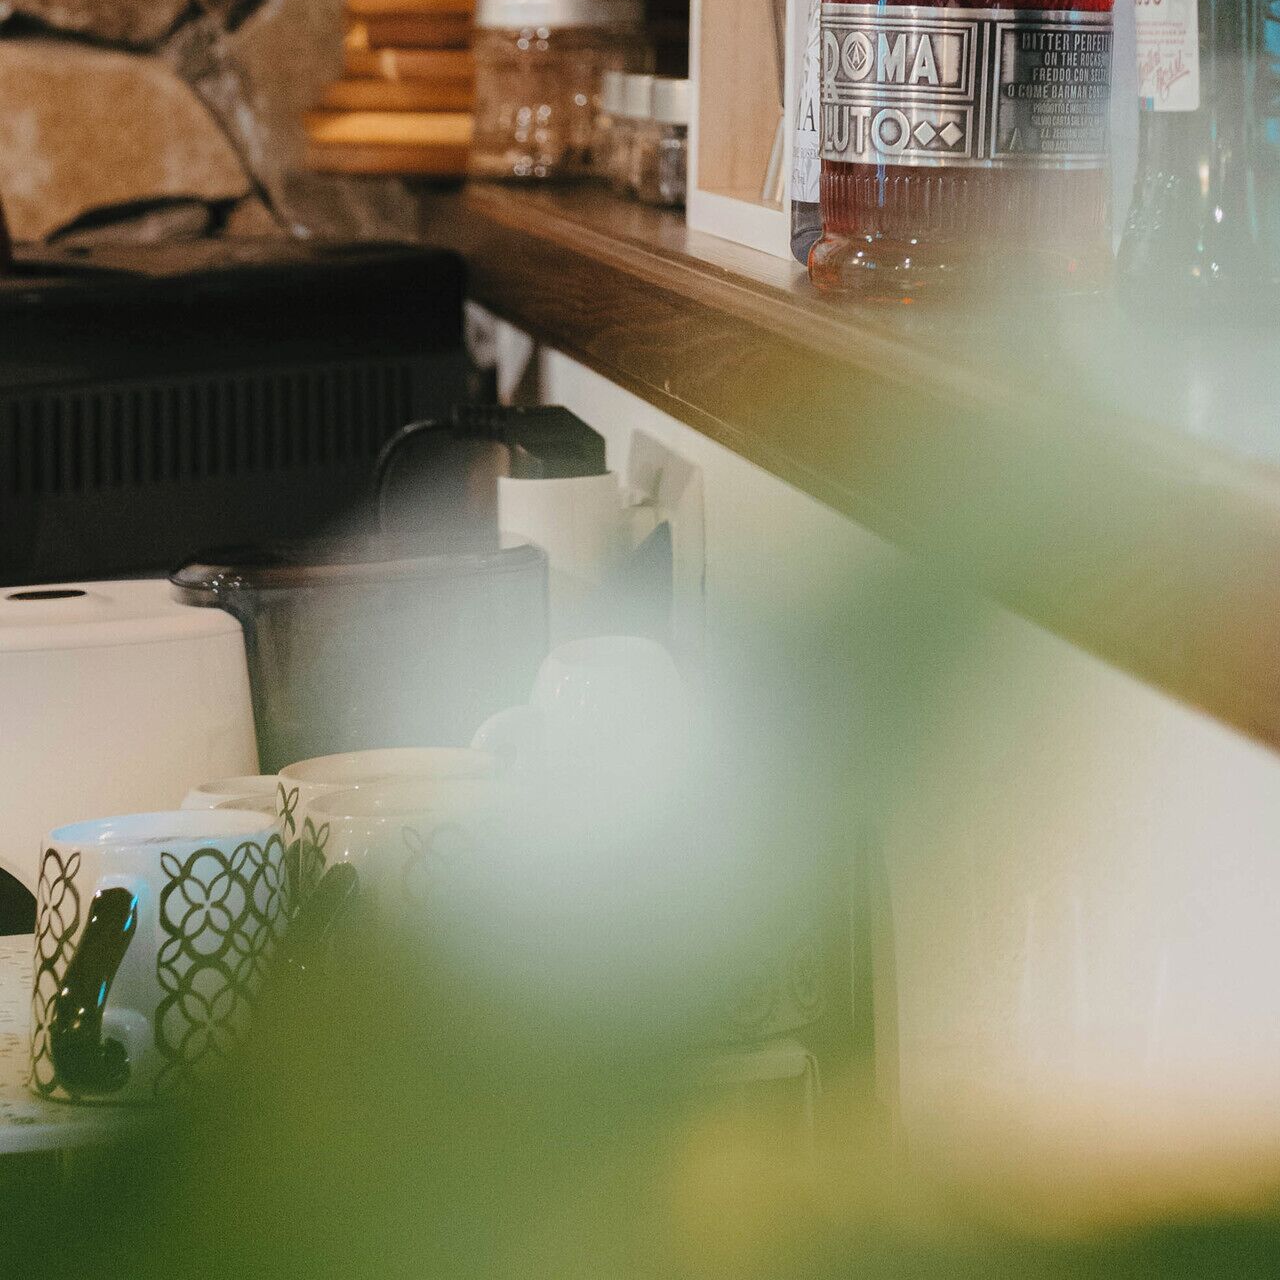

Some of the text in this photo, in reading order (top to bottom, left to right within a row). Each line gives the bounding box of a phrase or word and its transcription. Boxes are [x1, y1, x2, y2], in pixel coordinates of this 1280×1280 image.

[1022, 33, 1071, 52] BITTER
[1044, 52, 1058, 66] ON
[1061, 52, 1078, 67] THE
[1033, 67, 1071, 82] FREDDO
[1073, 68, 1089, 83] CON
[1051, 84, 1087, 100] BARMAN
